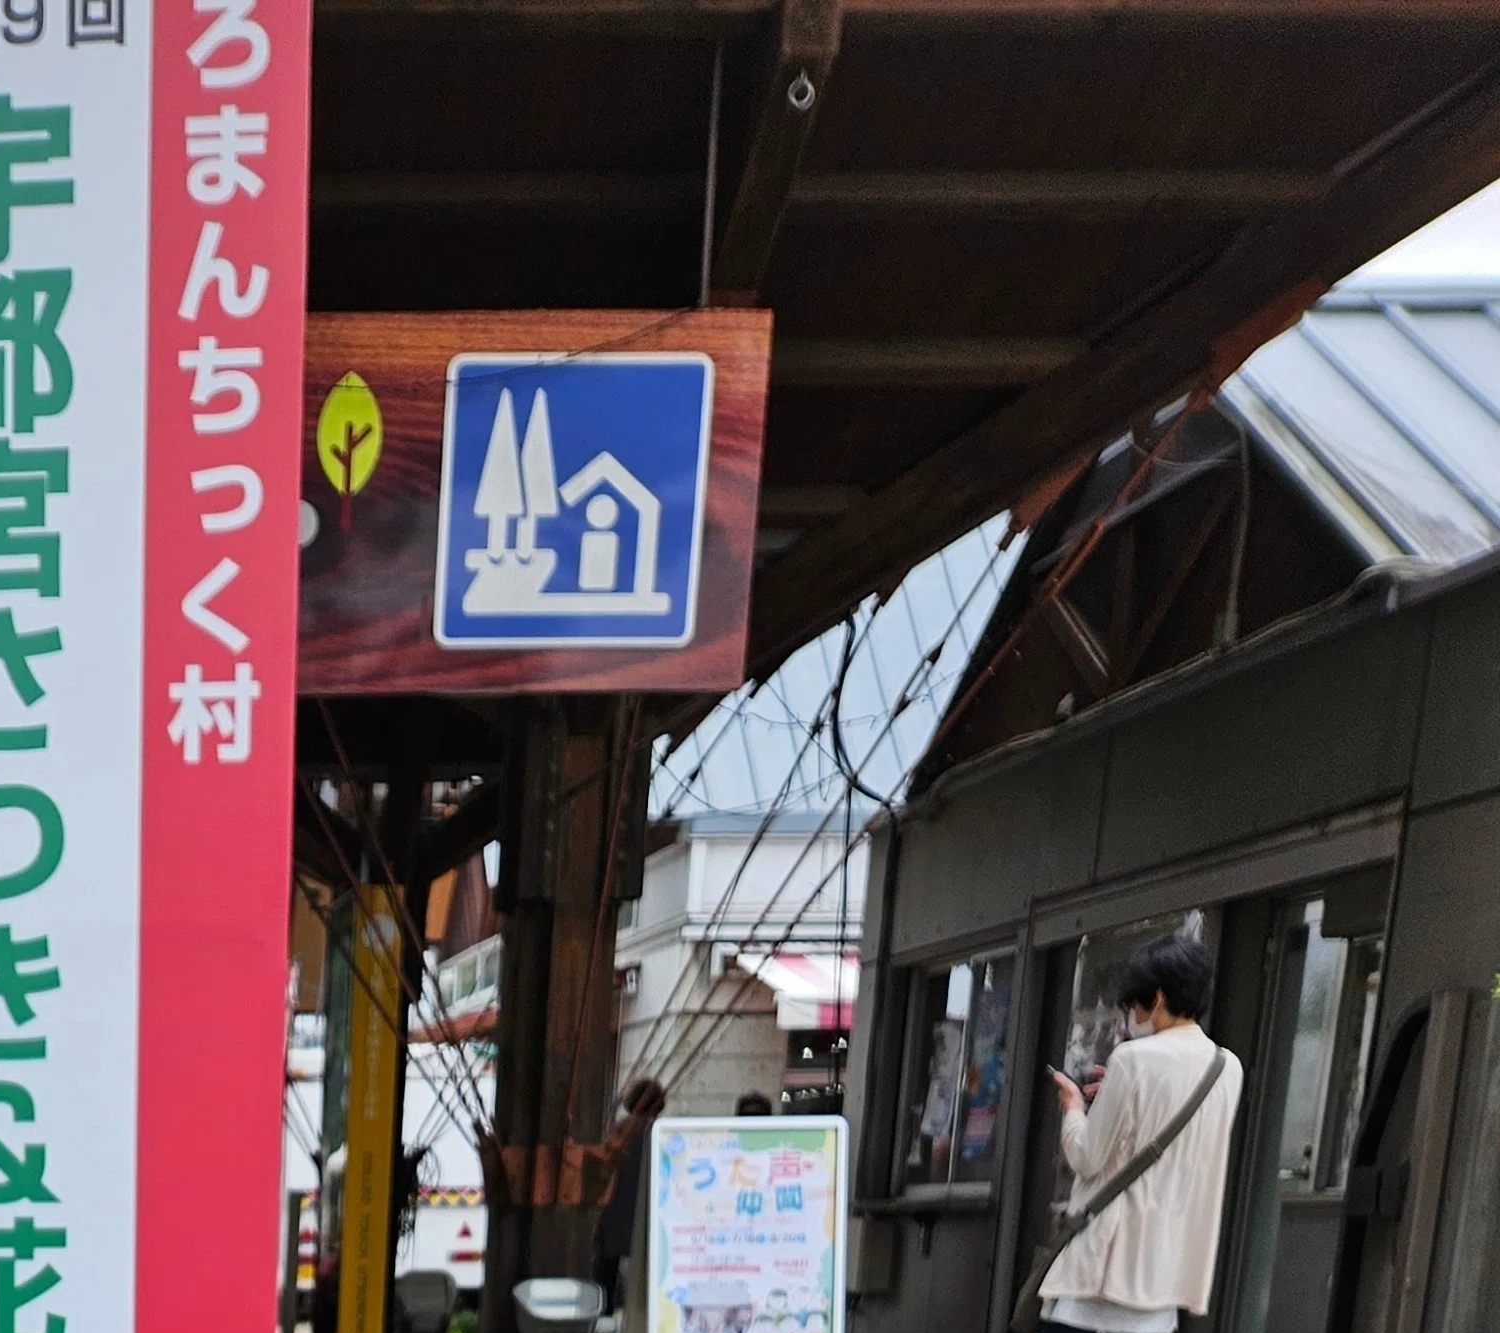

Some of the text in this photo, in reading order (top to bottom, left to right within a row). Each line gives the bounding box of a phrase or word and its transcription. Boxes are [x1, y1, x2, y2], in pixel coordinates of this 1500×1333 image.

[166, 0, 271, 764] ろまんちっく村
